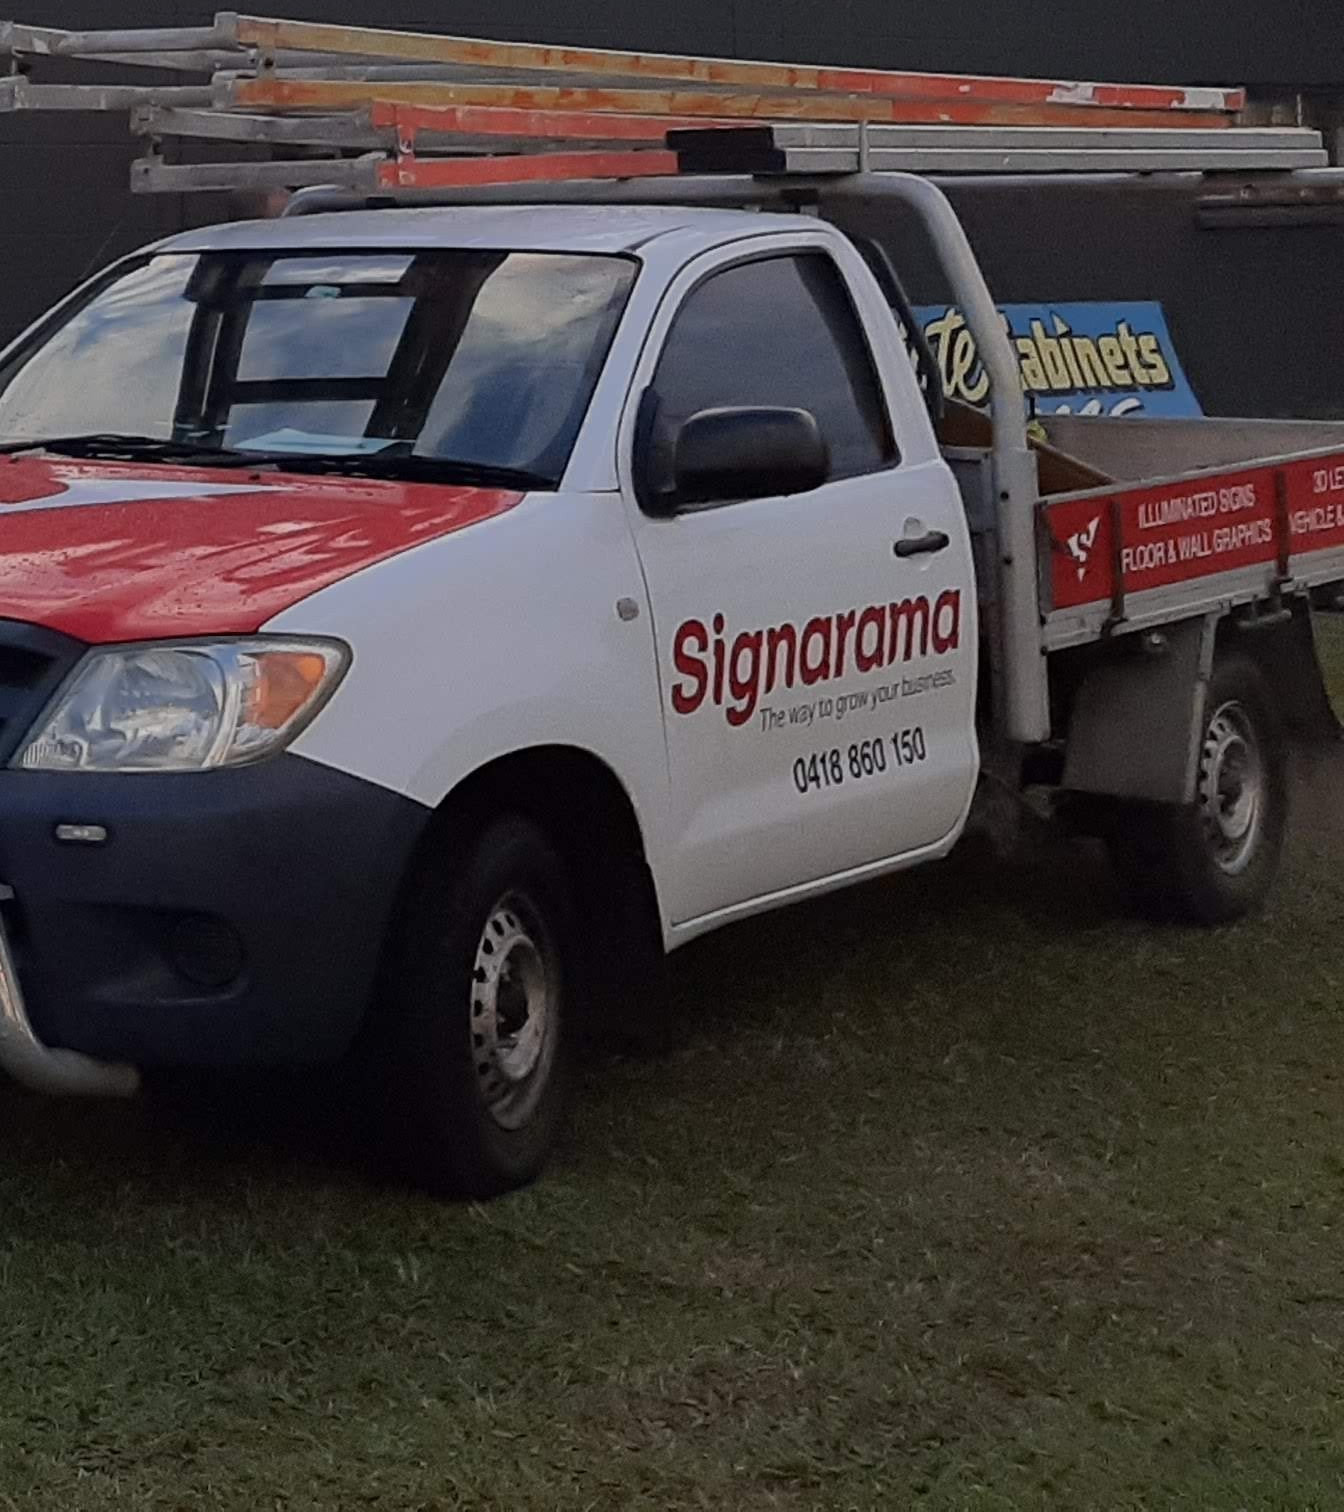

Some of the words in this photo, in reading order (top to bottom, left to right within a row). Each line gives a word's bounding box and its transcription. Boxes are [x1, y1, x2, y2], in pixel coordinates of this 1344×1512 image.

[999, 311, 1170, 391] abinets
[1138, 491, 1217, 529] ILLUMINATED
[1219, 484, 1256, 512] SIGNS
[1313, 470, 1328, 494] 3D
[1288, 505, 1335, 534] VEHICLE
[1121, 543, 1165, 574] FLOOR
[1167, 539, 1177, 564] &
[1178, 532, 1212, 560] WALL
[1213, 518, 1273, 554] GRAPHICS
[671, 589, 961, 726] Signarama
[760, 707, 785, 732] The
[788, 701, 816, 727] way
[818, 696, 833, 718] to
[836, 691, 868, 720] grow
[870, 683, 899, 710] your
[793, 749, 844, 794] 0418
[847, 738, 887, 779] 860
[890, 727, 927, 767] 150
